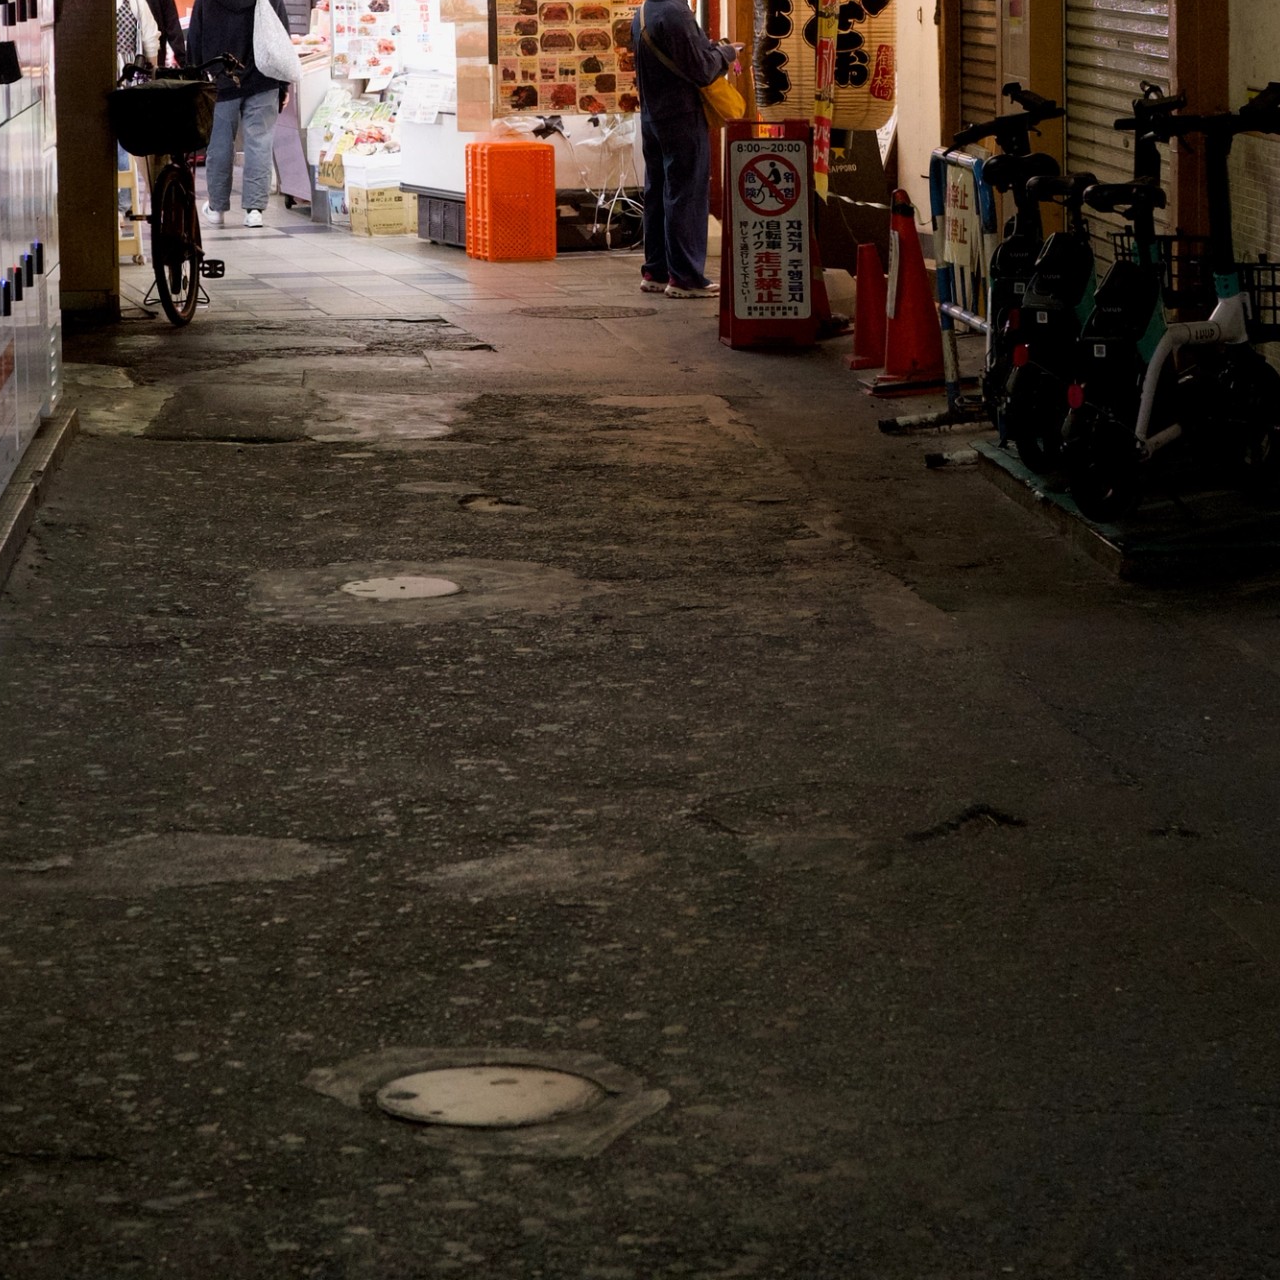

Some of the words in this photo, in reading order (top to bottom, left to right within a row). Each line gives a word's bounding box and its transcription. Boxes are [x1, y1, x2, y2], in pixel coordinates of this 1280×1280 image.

[766, 219, 782, 251] 自転車
[754, 252, 783, 304] 走行禁止
